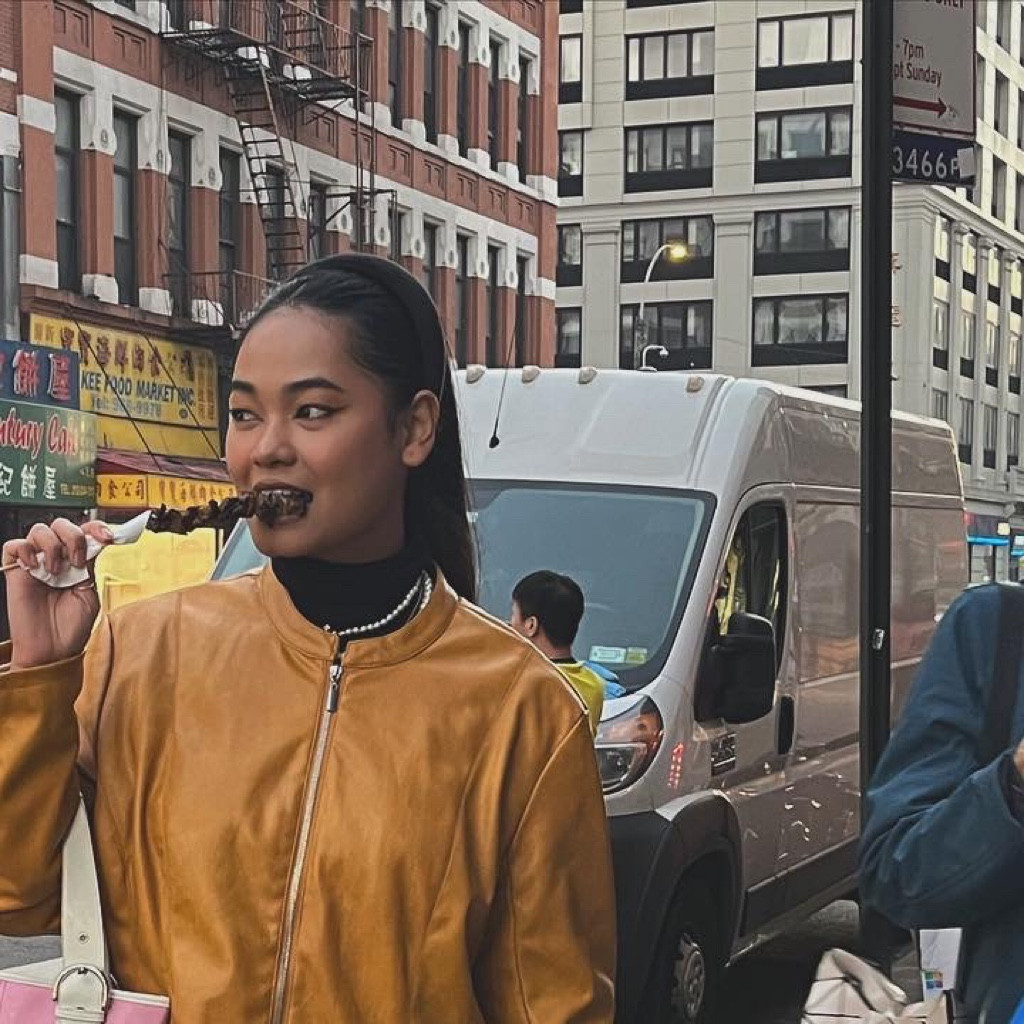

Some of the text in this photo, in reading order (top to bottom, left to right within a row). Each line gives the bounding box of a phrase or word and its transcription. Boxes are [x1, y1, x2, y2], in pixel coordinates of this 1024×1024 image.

[902, 38, 924, 60] 7pm
[906, 62, 942, 87] Sunday
[81, 370, 102, 392] KEE
[104, 374, 132, 396] FOOD
[136, 381, 175, 404] MARKET
